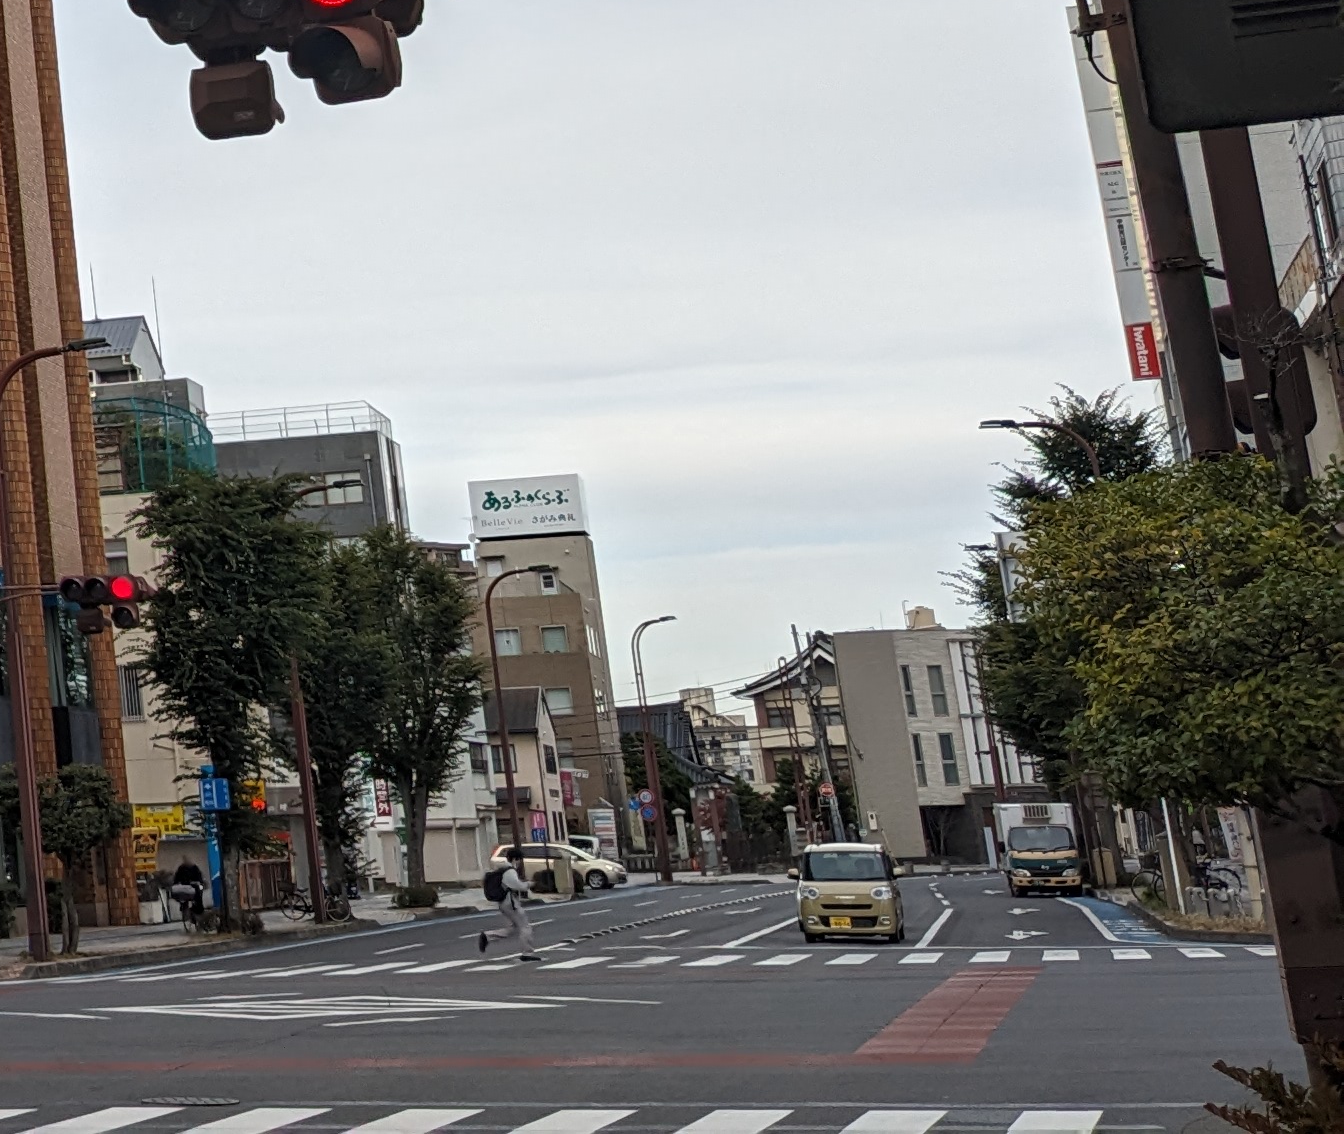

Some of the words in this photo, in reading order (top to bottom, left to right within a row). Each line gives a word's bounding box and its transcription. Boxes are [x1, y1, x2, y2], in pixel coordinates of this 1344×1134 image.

[1133, 326, 1152, 376] Iwatani
[532, 513, 576, 524] さがみ典礼
